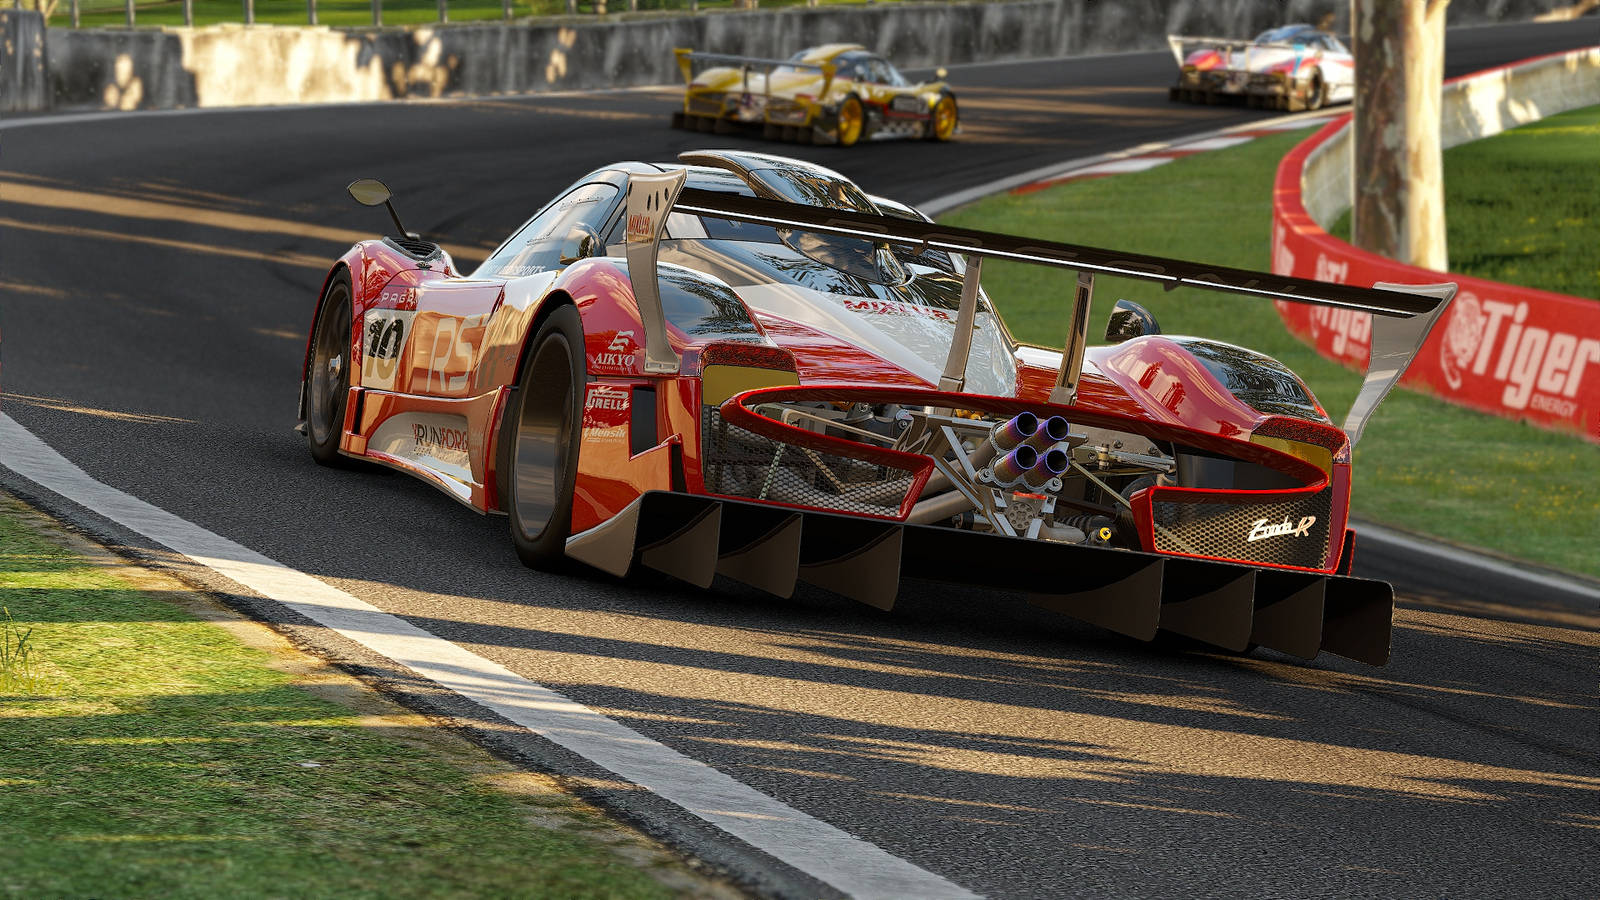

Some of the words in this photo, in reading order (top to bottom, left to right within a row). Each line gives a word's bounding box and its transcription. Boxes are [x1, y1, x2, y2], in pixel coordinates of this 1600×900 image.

[593, 352, 634, 367] AIKYO
[1473, 300, 1600, 410] Tiger
[1247, 515, 1296, 542] Zonda
[1295, 516, 1316, 537] R
